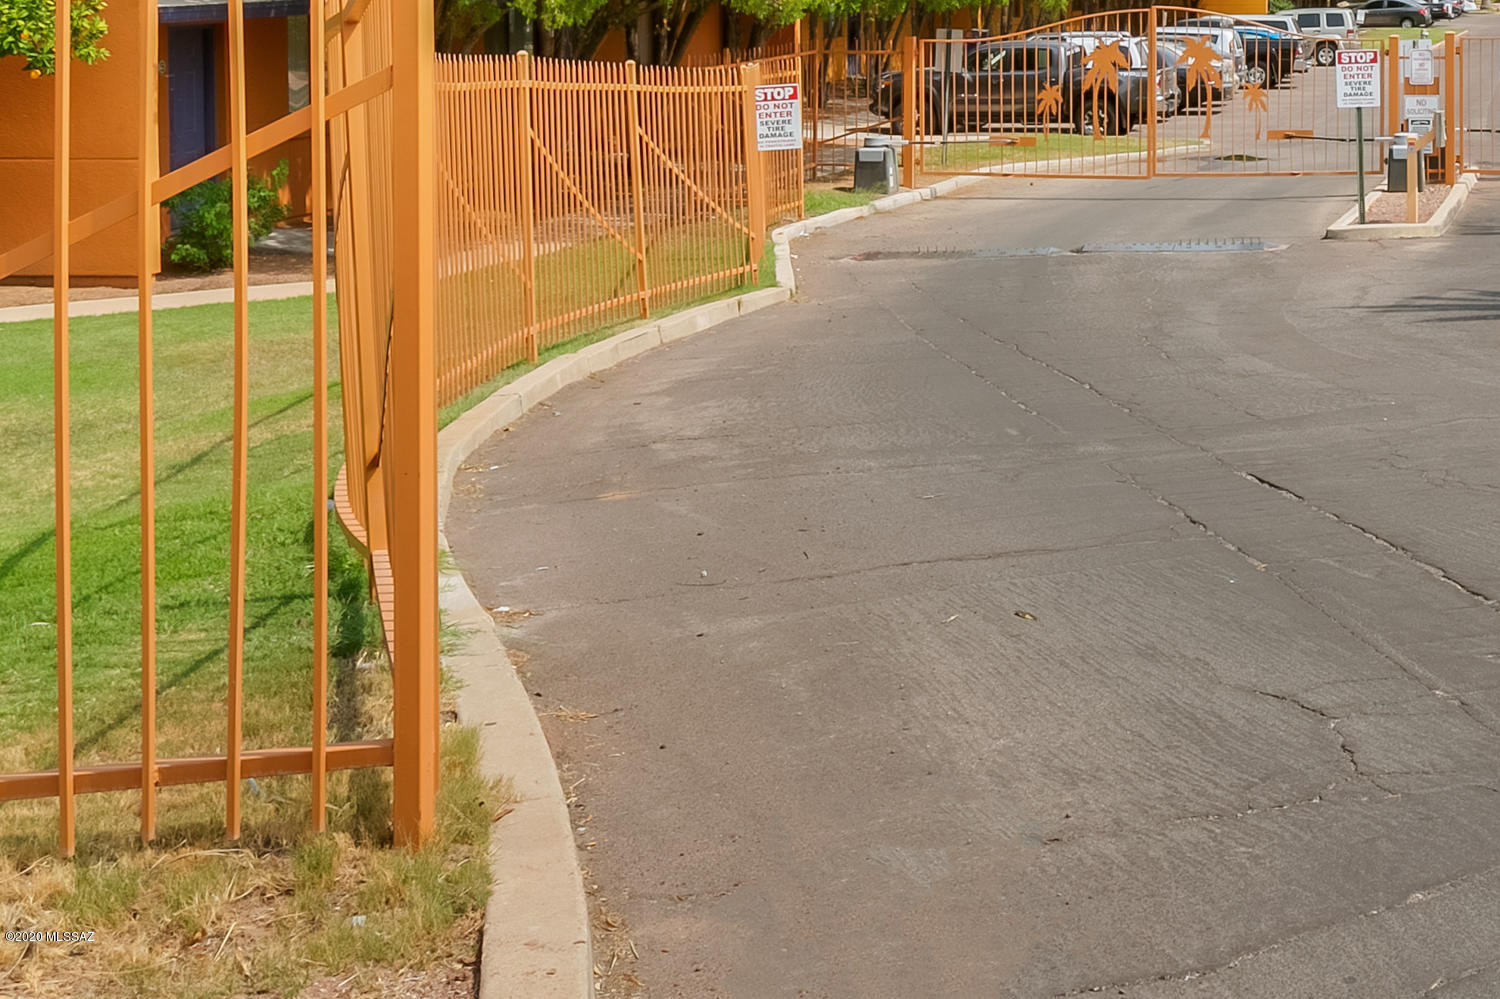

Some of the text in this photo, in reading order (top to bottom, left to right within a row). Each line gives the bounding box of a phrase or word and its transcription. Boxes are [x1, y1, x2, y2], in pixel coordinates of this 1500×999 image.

[1341, 52, 1374, 63] STOP
[755, 88, 794, 100] STOP
[758, 110, 792, 118] ENTER
